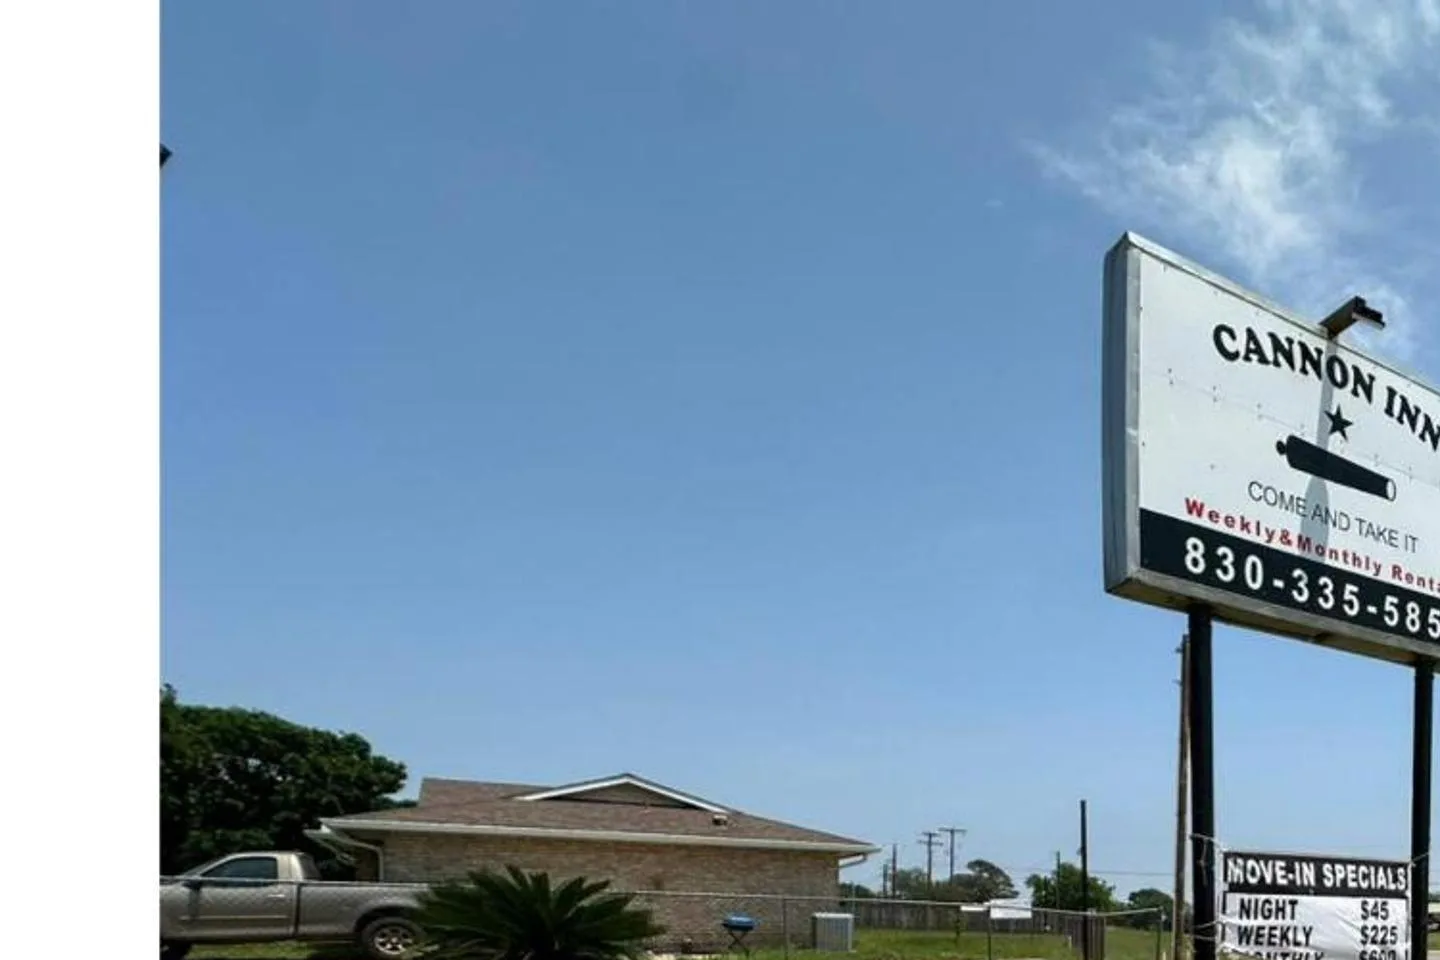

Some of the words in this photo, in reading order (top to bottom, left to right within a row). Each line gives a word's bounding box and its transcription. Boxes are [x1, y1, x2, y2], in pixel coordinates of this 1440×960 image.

[1213, 324, 1375, 404] CANNON
[1184, 497, 1383, 577] Weekly&Monthly
[1248, 481, 1307, 518] COME
[1311, 508, 1351, 532] AND
[1354, 518, 1399, 549] TAKE
[1404, 534, 1419, 553] IT
[1226, 857, 1316, 886] MOVE-IN
[1322, 863, 1407, 890] SPECIALS
[1238, 898, 1298, 921] NIGHT
[1360, 900, 1390, 921] $45
[1236, 925, 1313, 947] WEEKLY
[1359, 925, 1398, 946] $225
